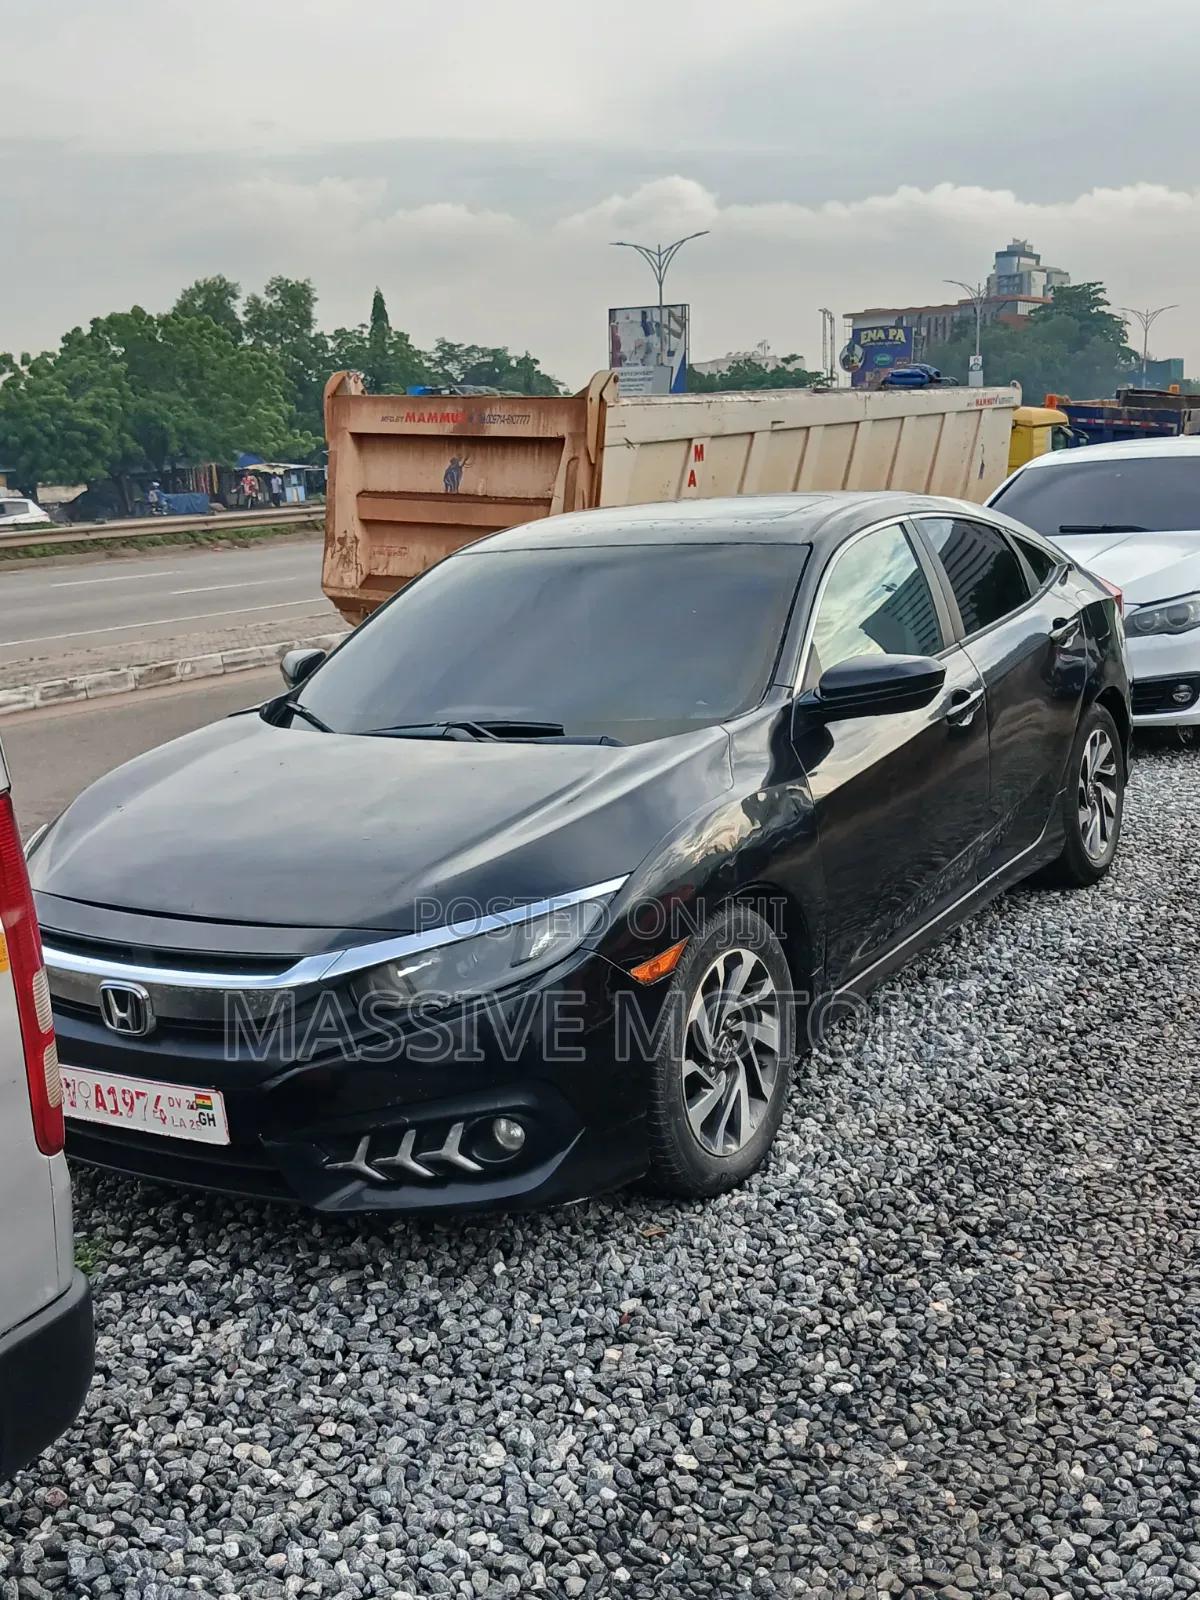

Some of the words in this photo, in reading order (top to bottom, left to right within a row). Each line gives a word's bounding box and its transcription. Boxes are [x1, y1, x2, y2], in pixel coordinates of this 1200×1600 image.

[860, 329, 886, 345] ENA
[888, 328, 907, 343] PA
[198, 1111, 217, 1128] GH
